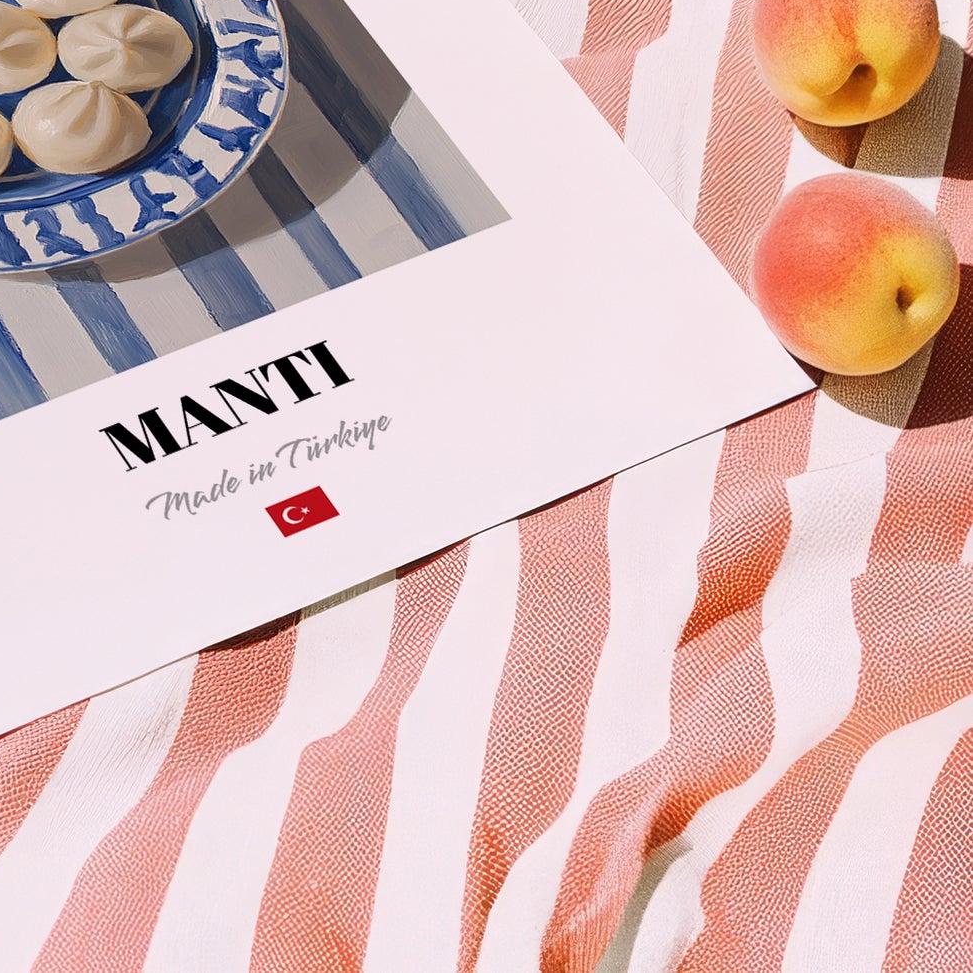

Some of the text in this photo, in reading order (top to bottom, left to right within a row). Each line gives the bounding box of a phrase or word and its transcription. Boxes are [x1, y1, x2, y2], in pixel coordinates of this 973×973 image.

[98, 340, 355, 472] MANTI
[145, 415, 392, 520] Made in Türkiye
